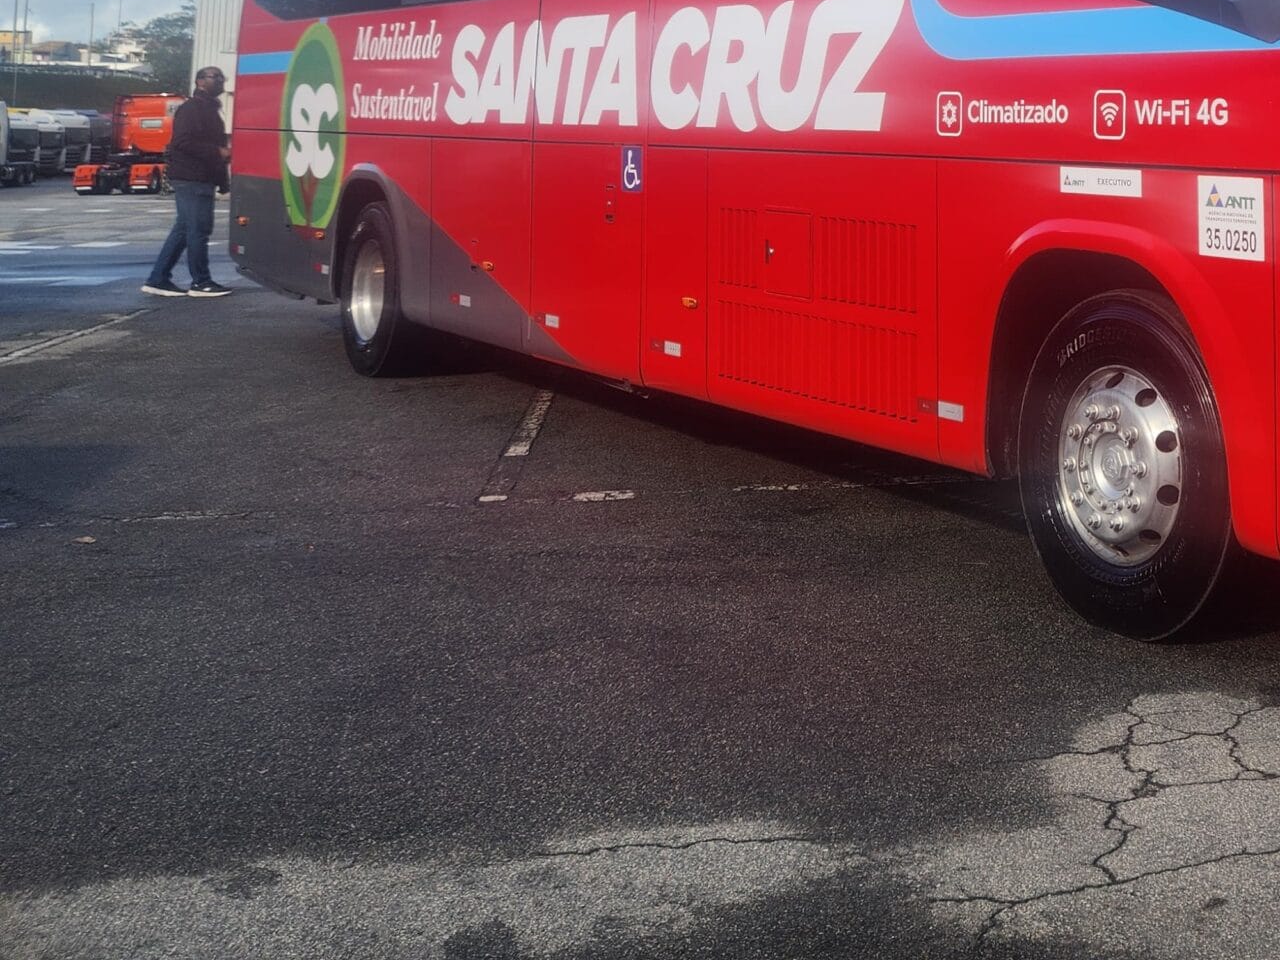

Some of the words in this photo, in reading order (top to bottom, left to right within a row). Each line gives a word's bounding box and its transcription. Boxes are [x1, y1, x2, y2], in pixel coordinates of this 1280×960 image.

[353, 19, 442, 60] Mobilidade
[445, 11, 638, 125] SANTA
[351, 82, 440, 122] Sustentável
[967, 98, 1069, 124] Climatizado
[1134, 99, 1190, 125] Wi-Fi
[1196, 98, 1229, 125] 4G
[1224, 195, 1256, 210] ANTT
[1206, 227, 1257, 253] 35.0250
